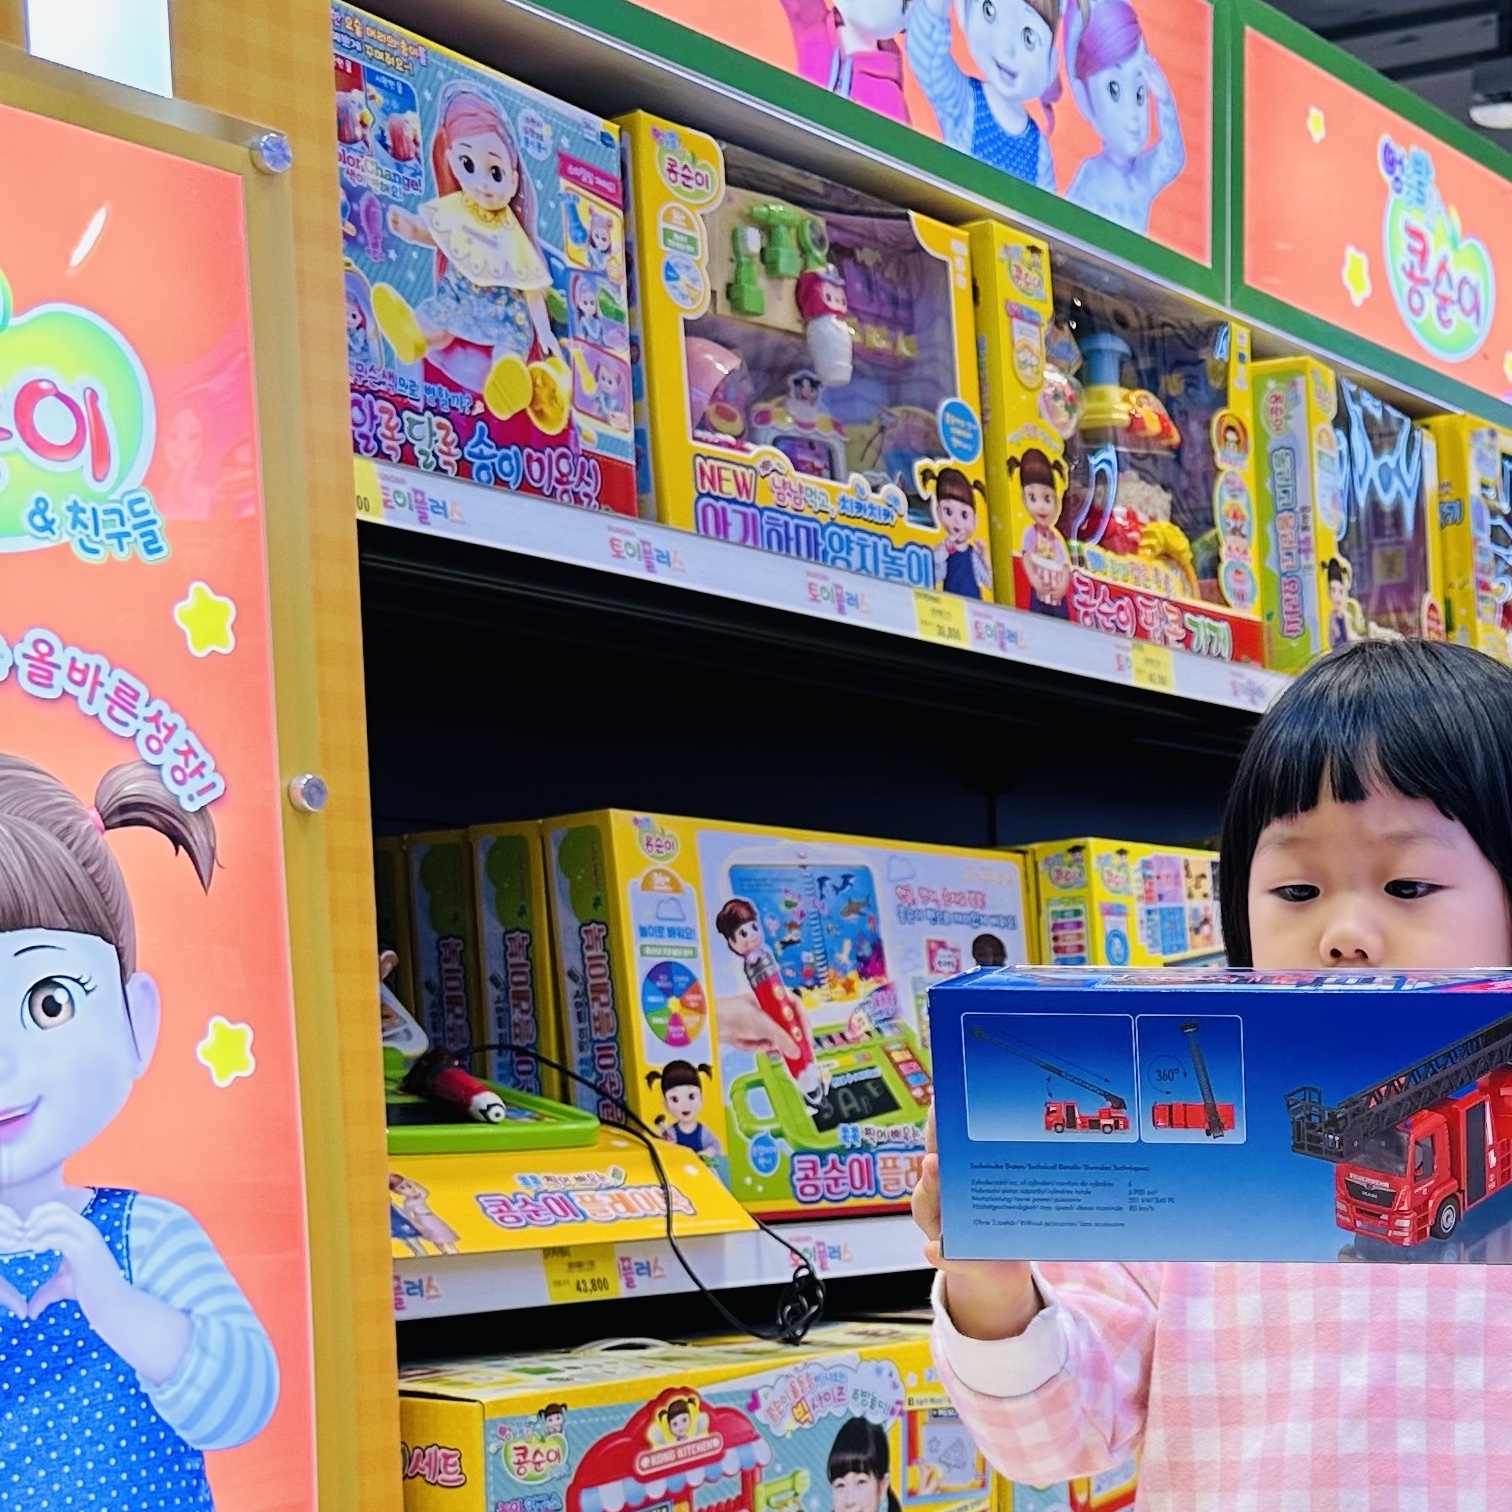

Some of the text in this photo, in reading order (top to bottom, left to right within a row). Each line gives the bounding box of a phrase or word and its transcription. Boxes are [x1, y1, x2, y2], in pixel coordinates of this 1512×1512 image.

[666, 156, 711, 191] 콩순이
[1403, 220, 1481, 328] 콩순이
[697, 458, 755, 502] NEW
[28, 494, 165, 557] & 친구들
[608, 536, 687, 574] 토이플러스
[806, 580, 871, 616] 토이플러스
[1072, 570, 1137, 638] 콩순이
[1184, 612, 1233, 663] 가게
[22, 637, 218, 803] 올바른 성장!
[644, 835, 676, 854] 콩순이
[504, 931, 536, 1044] 플레이북
[580, 923, 617, 1040] 플레이북
[794, 1153, 874, 1201] 콩순이
[481, 1193, 581, 1229] 콩순이
[576, 1277, 609, 1293] 43,800
[618, 1256, 667, 1289] 플러스
[393, 1275, 442, 1312] 플러스
[407, 1447, 467, 1486] 세트
[511, 1445, 562, 1477] 콩순이
[651, 1441, 713, 1466] KONG KITCHEN
